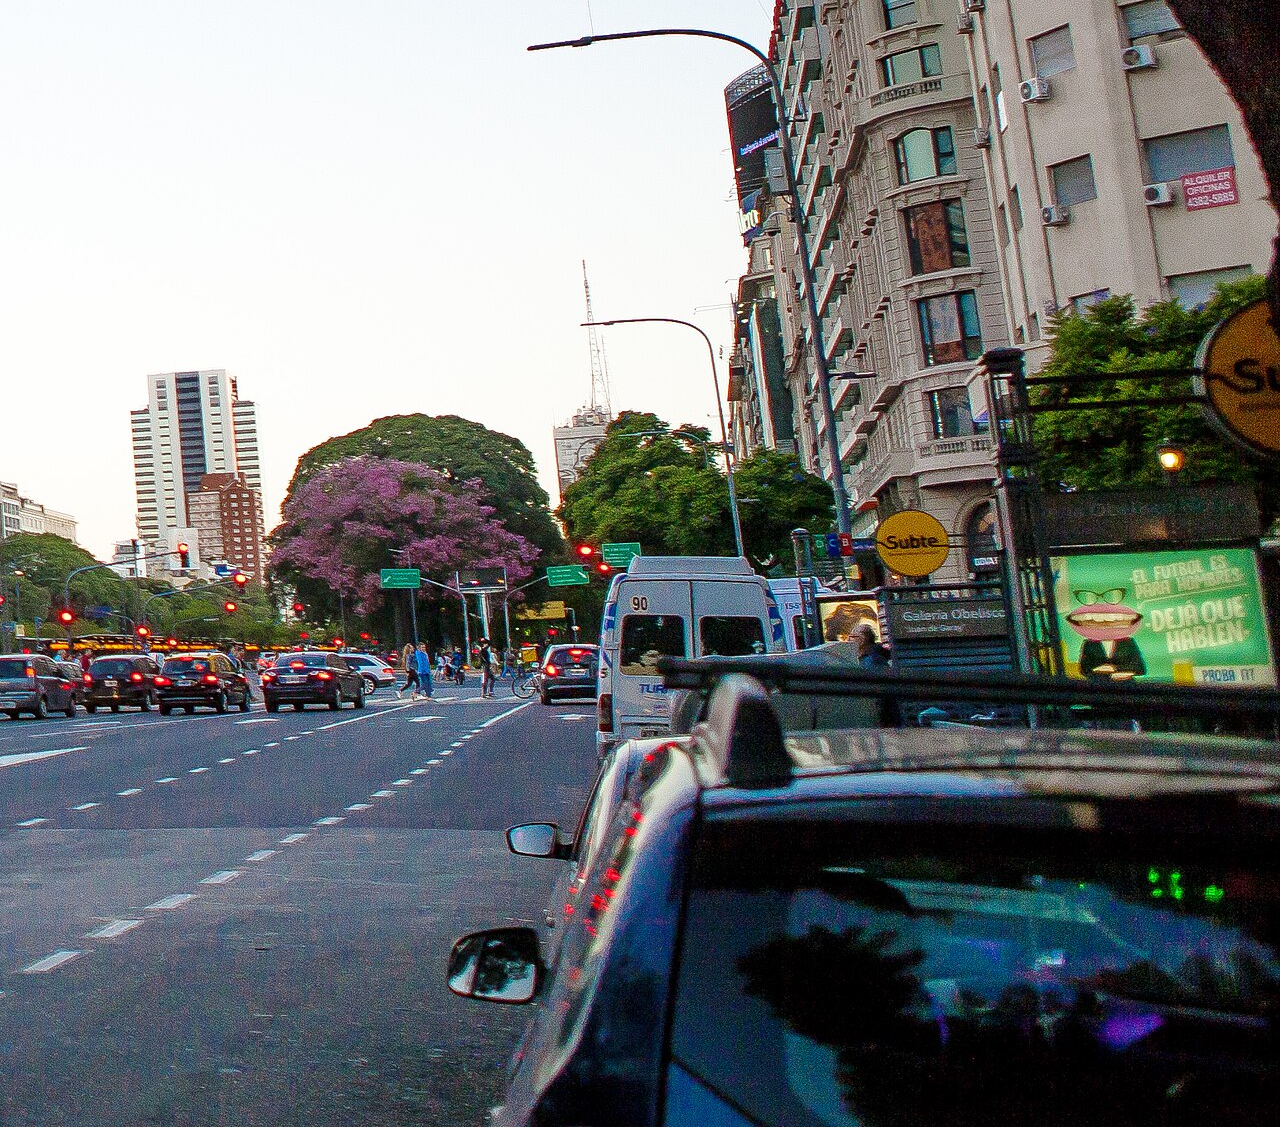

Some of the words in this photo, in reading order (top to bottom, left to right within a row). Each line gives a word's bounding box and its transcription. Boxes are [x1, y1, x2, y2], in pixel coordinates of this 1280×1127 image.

[1184, 171, 1231, 186] ALQUILER
[1186, 181, 1231, 196] OFICINAS
[841, 537, 850, 547] B
[886, 534, 939, 550] Subte
[1210, 554, 1227, 571] ES
[1135, 579, 1171, 600] PARA
[632, 596, 648, 611] 90
[1201, 595, 1246, 624] QUE
[639, 683, 669, 695] TUR
